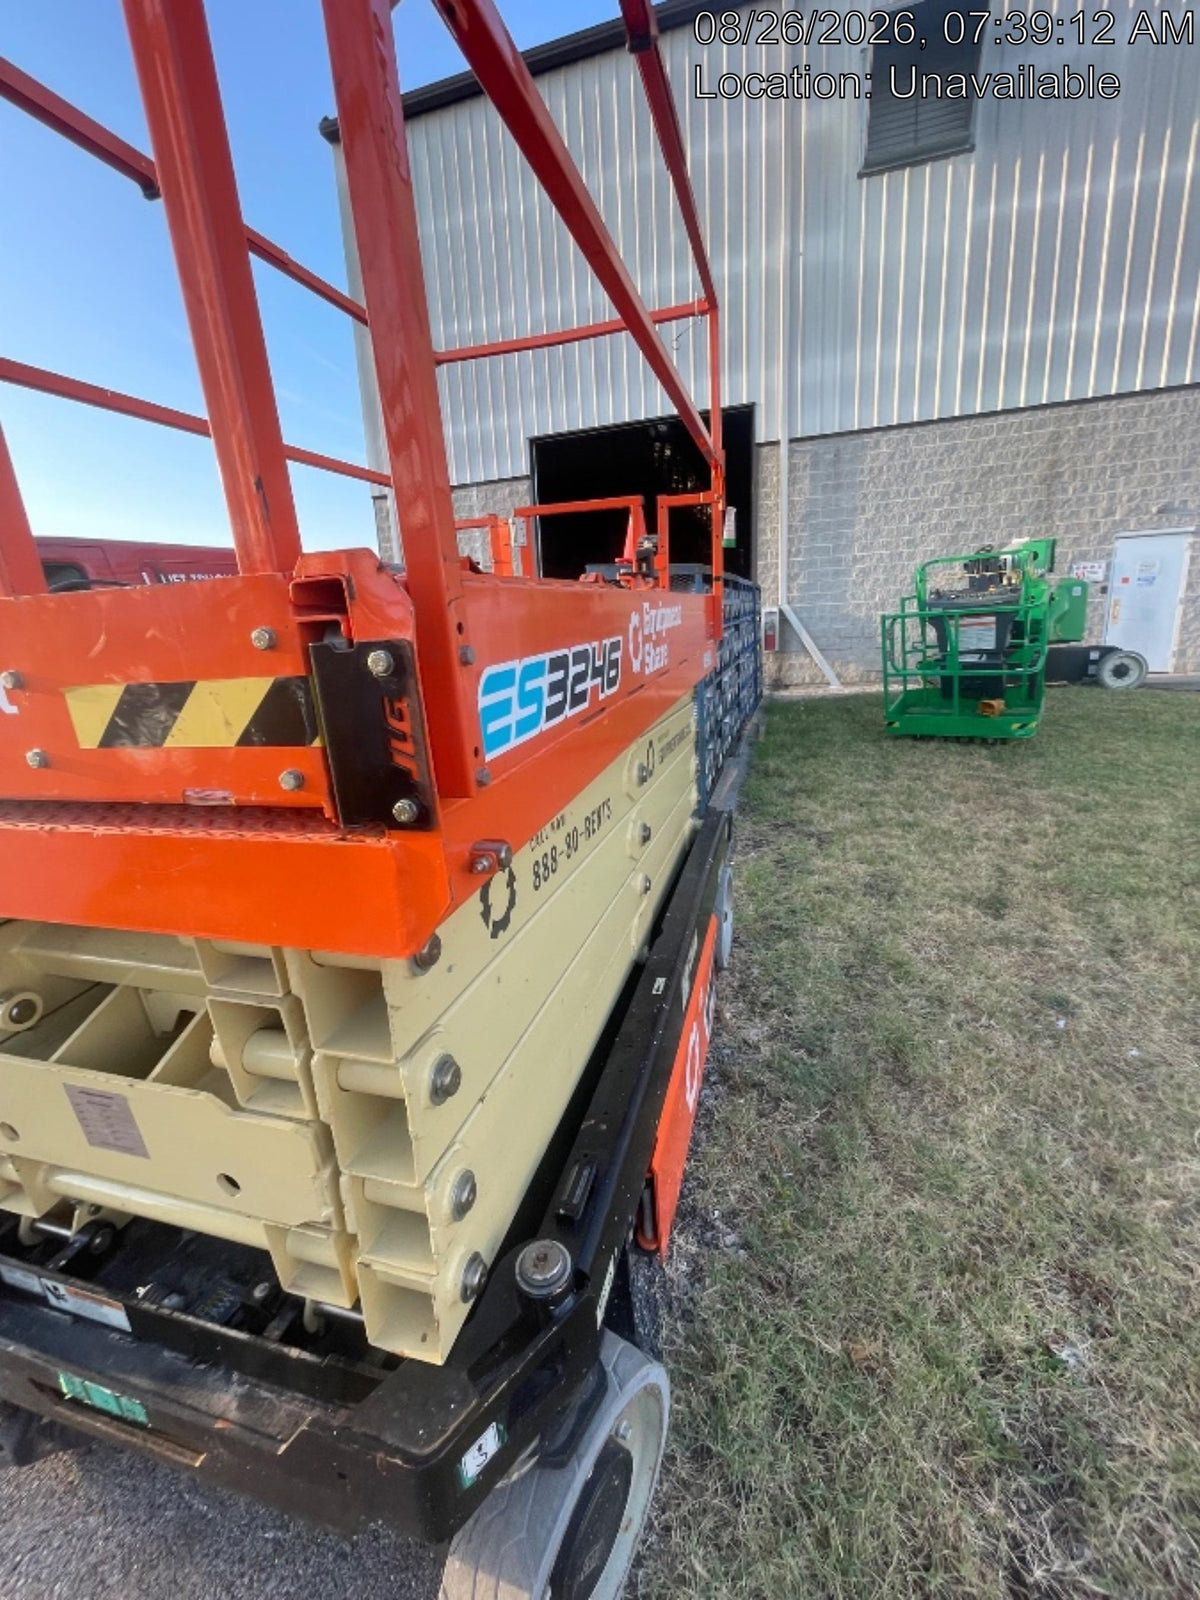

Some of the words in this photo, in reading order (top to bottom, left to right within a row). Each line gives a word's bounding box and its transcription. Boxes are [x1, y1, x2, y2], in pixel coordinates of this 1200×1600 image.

[642, 600, 682, 641] Equipment
[644, 641, 668, 676] Share
[383, 696, 421, 782] JLG
[477, 636, 623, 763] ES3246
[532, 797, 612, 892] 888-80-RENTS
